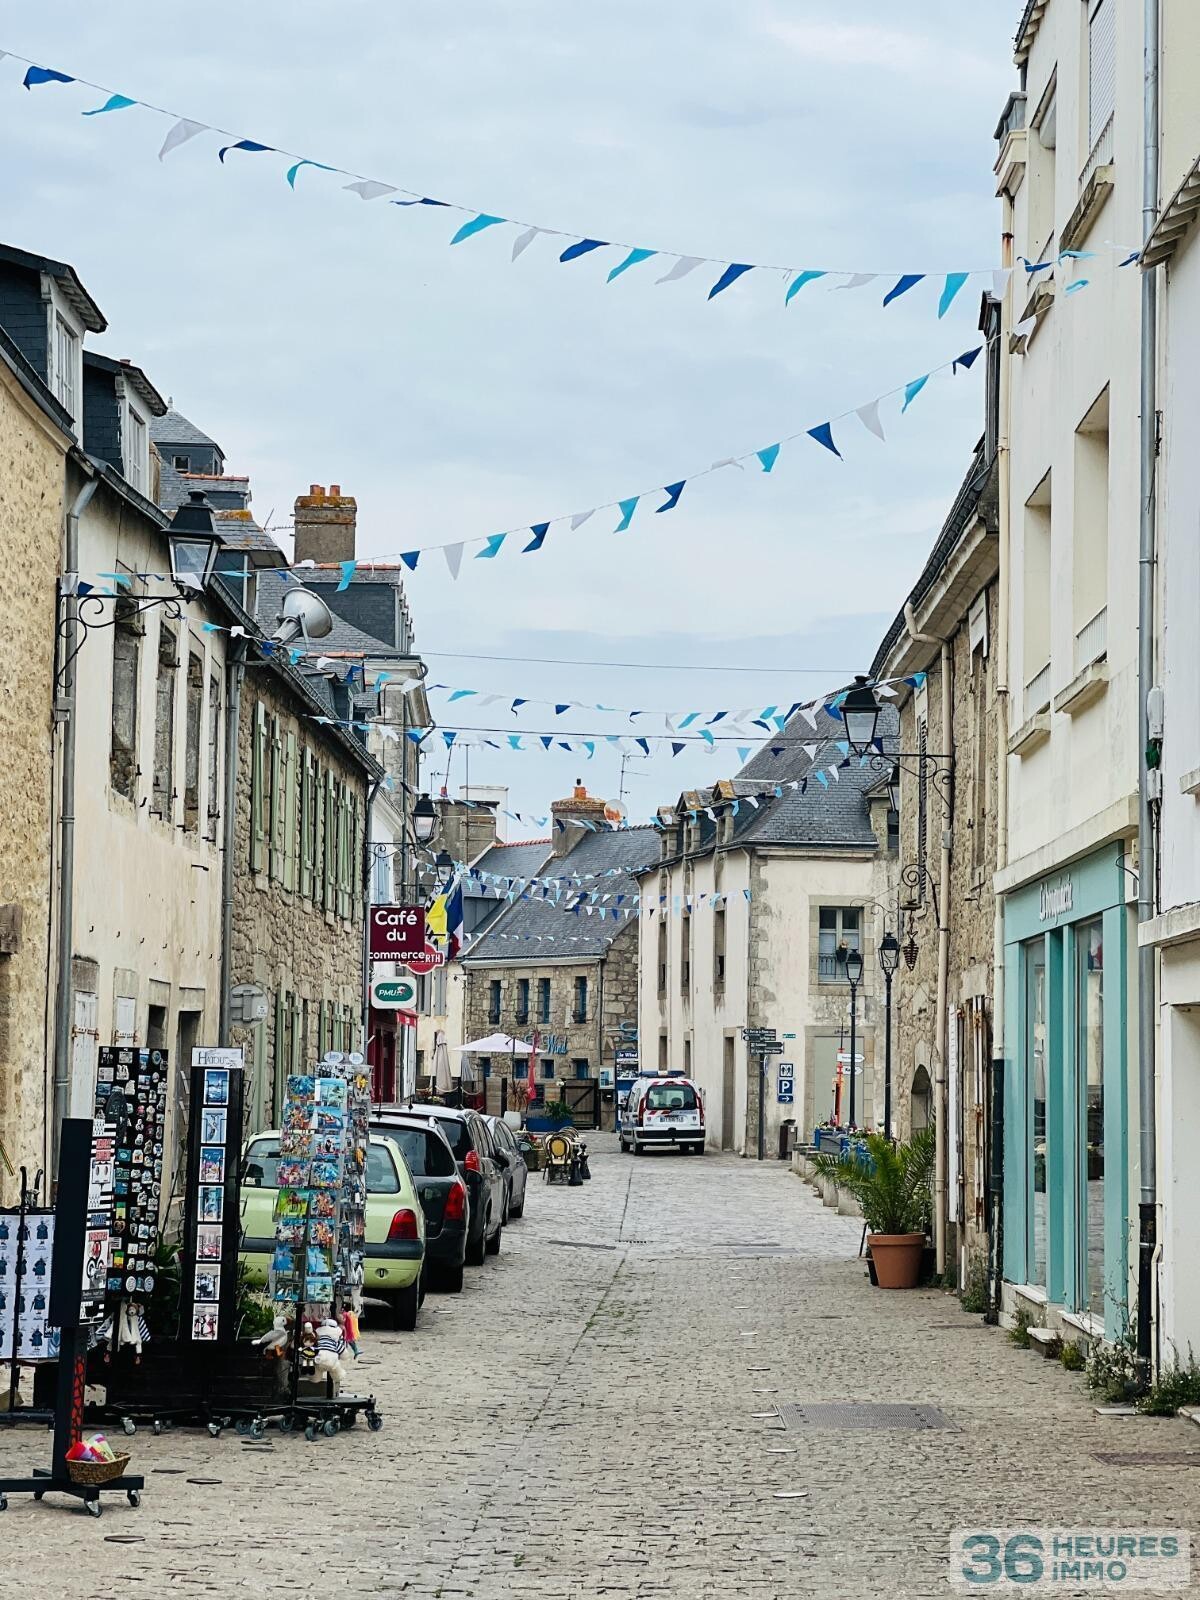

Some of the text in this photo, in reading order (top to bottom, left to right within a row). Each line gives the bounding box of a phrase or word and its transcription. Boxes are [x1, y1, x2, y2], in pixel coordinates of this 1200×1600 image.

[374, 910, 418, 926] Café
[386, 928, 407, 942] du
[368, 951, 425, 960] commerce
[378, 989, 397, 997] PMU
[781, 1080, 791, 1093] P
